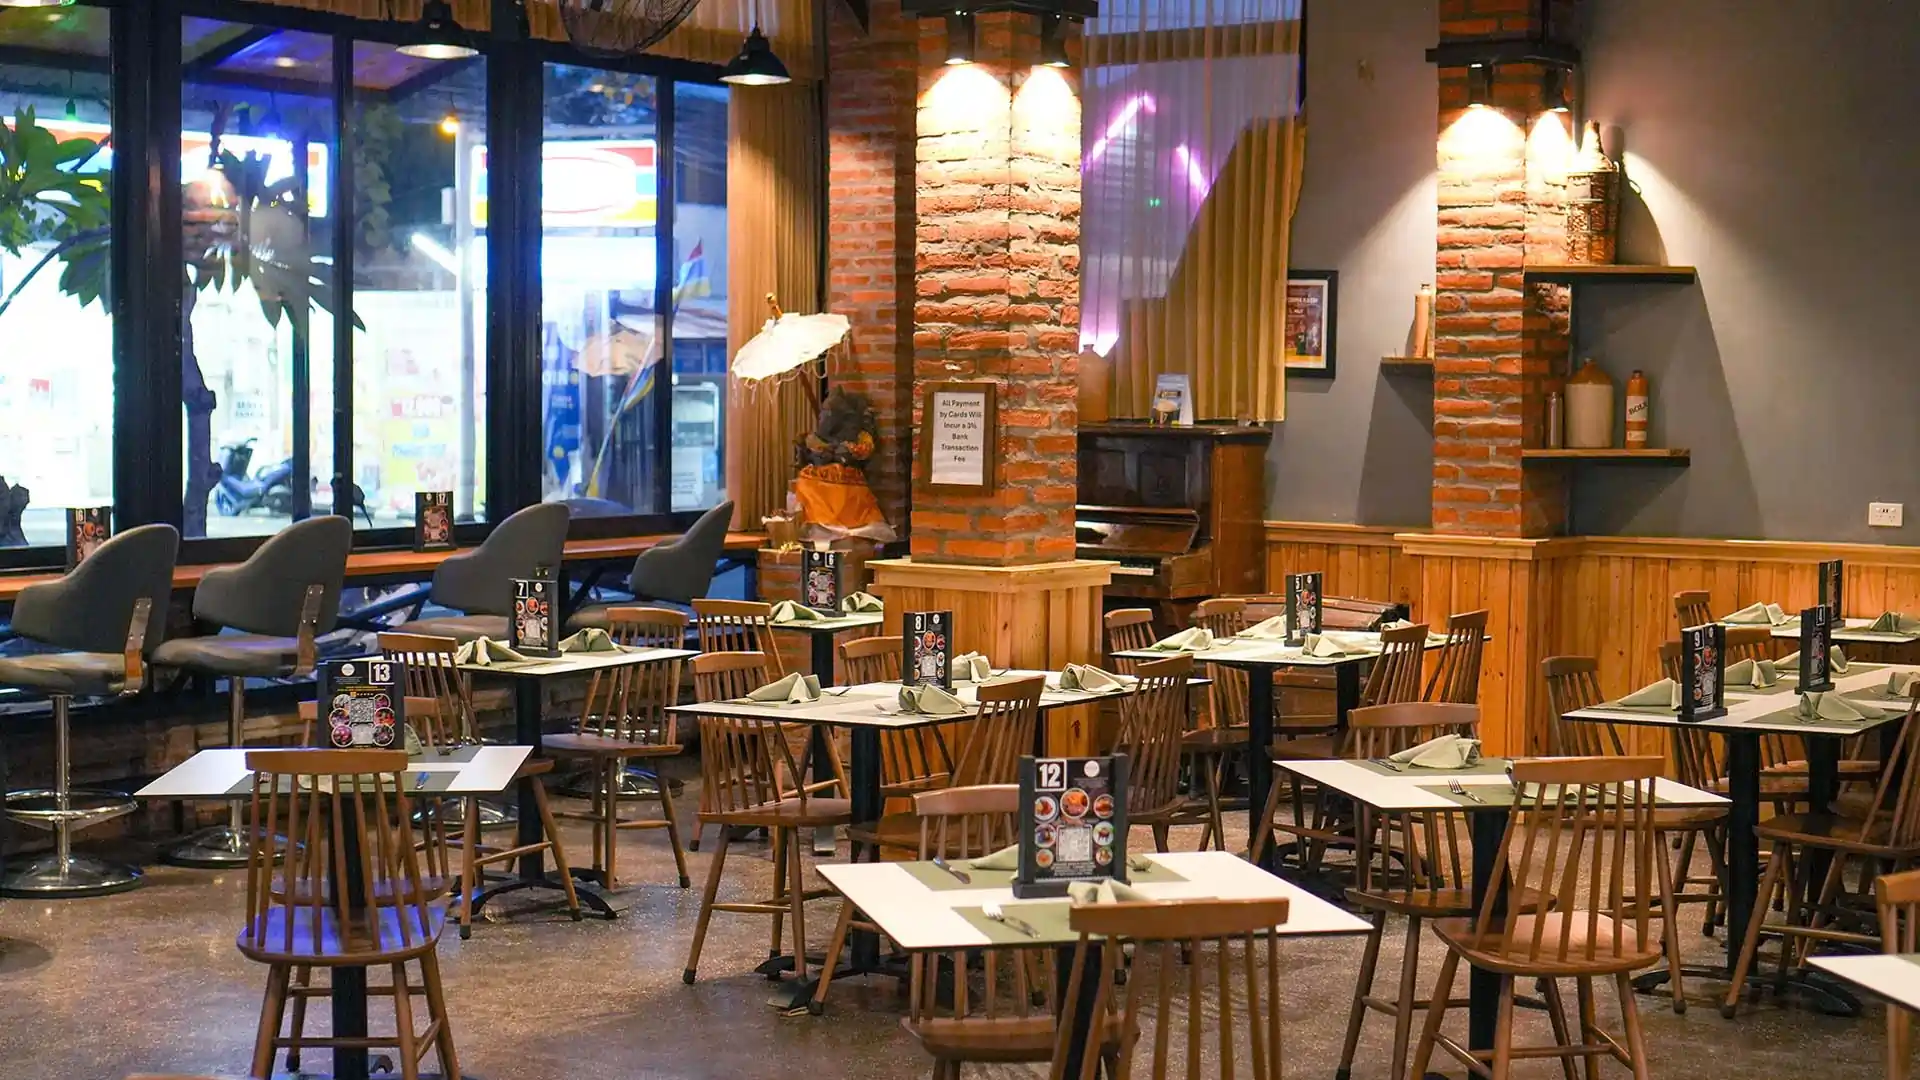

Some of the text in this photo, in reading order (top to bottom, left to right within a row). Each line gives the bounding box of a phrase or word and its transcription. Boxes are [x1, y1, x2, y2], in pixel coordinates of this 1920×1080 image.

[942, 399, 980, 408] All Payment
[939, 411, 948, 419] by
[967, 422, 977, 430] 3%
[941, 444, 979, 452] Transaction
[438, 493, 446, 504] 17
[518, 582, 524, 596] 7
[915, 615, 922, 630] 8
[1694, 631, 1700, 647] 9
[372, 663, 391, 682] 13
[1039, 763, 1061, 787] 12
